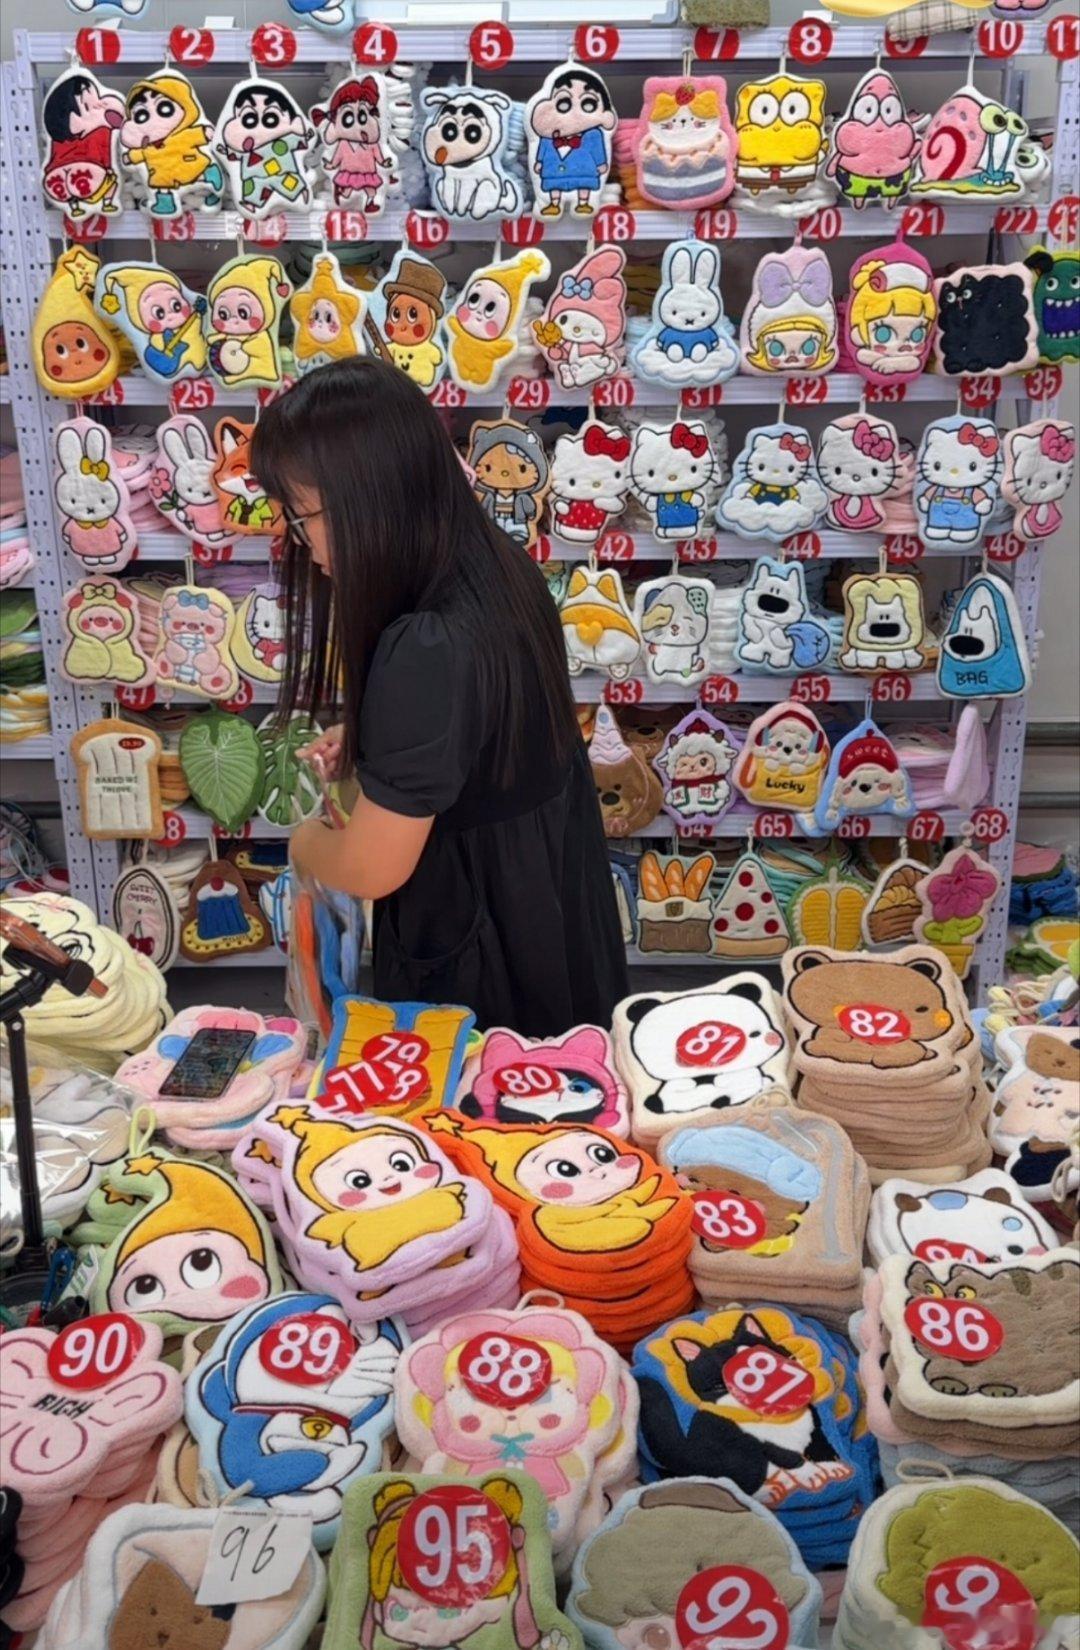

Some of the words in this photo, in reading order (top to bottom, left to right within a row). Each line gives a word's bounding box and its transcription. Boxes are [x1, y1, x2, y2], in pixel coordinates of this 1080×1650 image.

[88, 31, 103, 62] 1
[181, 29, 203, 60] 2
[263, 30, 285, 61] 3
[363, 30, 386, 61] 4
[480, 29, 501, 61] 5
[586, 26, 607, 57] 6
[707, 27, 726, 58] 7
[800, 25, 821, 56] 8
[984, 21, 1016, 50] 10
[1052, 20, 1080, 51] 11
[330, 211, 362, 240] 15
[412, 215, 443, 241] 16
[598, 213, 629, 240] 18
[698, 210, 731, 239] 19
[802, 209, 836, 238] 20
[907, 206, 938, 235] 21
[1000, 207, 1031, 234] 22
[179, 381, 210, 407] 25
[432, 380, 460, 406] 28
[512, 380, 543, 406] 29
[598, 379, 628, 406] 30
[791, 378, 822, 403] 32
[964, 376, 994, 401] 34
[1029, 370, 1055, 395] 35
[600, 535, 627, 559] 42
[683, 535, 711, 559] 43
[787, 535, 814, 558] 44
[890, 536, 918, 558] 45
[990, 533, 1019, 556] 46
[609, 680, 636, 703] 53
[705, 680, 732, 702] 54
[797, 678, 824, 700] 55
[878, 678, 905, 700] 56
[955, 670, 988, 686] BAG
[765, 777, 806, 794] Lucky
[760, 814, 787, 837] 65
[838, 817, 864, 837] 66
[912, 818, 939, 841] 67
[974, 814, 1002, 837] 68
[849, 1008, 903, 1037] 82
[371, 1035, 422, 1064] 79
[684, 1025, 741, 1063] 81
[328, 1061, 385, 1102] 77
[500, 1066, 552, 1094] 80
[694, 1199, 757, 1239] 83
[918, 1301, 989, 1352] 86
[59, 1322, 128, 1377] 90
[270, 1322, 341, 1376] 89
[468, 1336, 541, 1397] 88
[733, 1351, 809, 1405] 87
[31, 1393, 95, 1420] RICH
[221, 1524, 278, 1582] 96
[414, 1504, 493, 1588] 95
